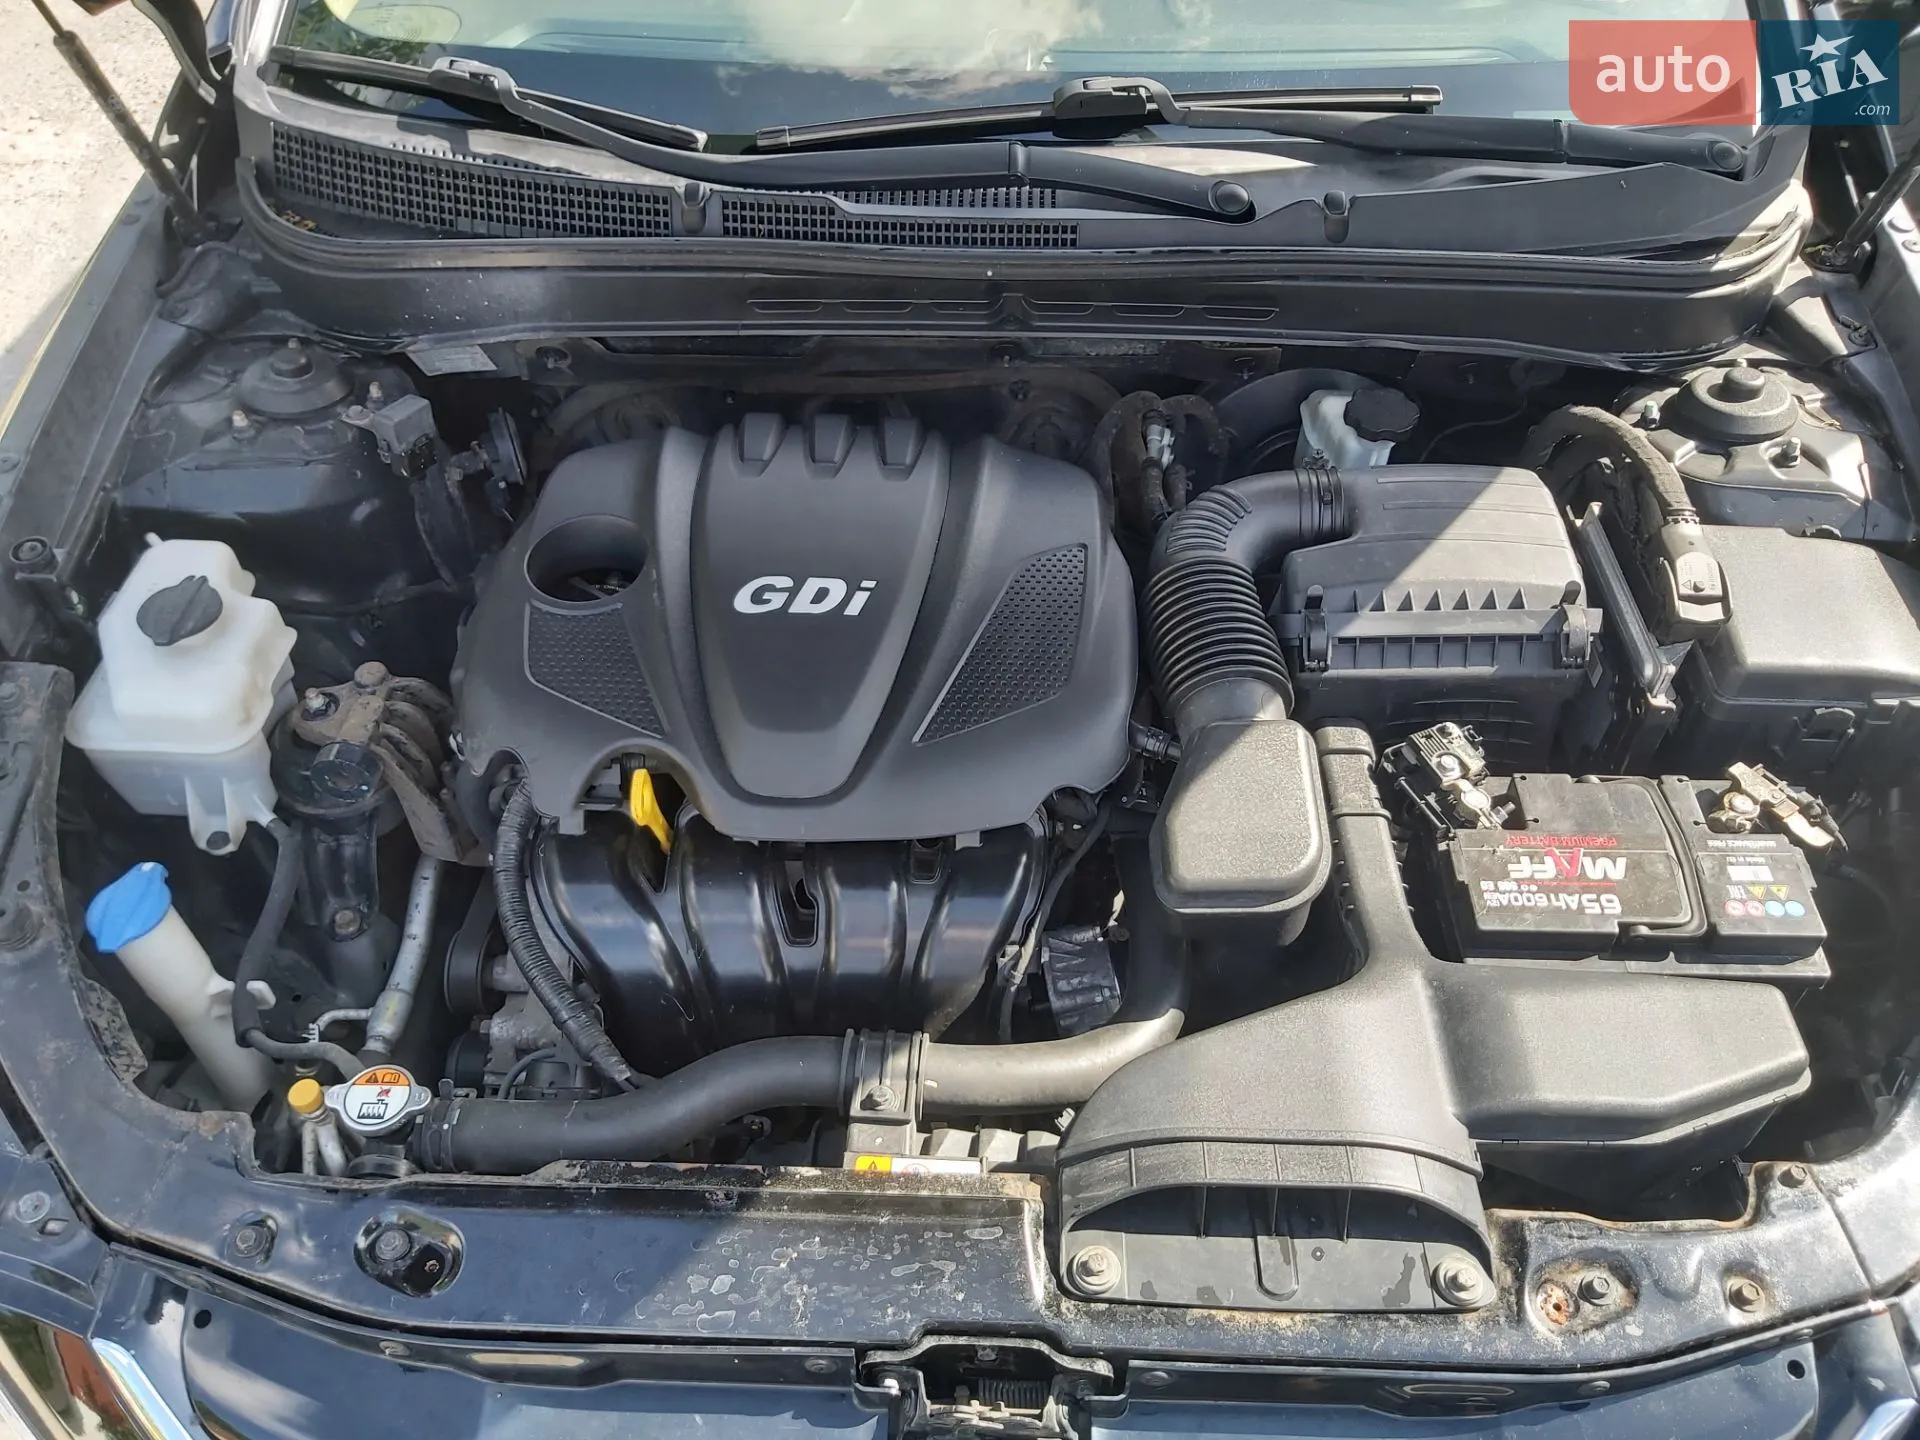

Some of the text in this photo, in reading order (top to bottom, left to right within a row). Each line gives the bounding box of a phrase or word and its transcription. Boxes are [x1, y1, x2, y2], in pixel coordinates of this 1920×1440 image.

[733, 575, 879, 616] GDi
[1505, 834, 1617, 847] PREMIUM BATTERY
[1507, 847, 1627, 880] MAFF
